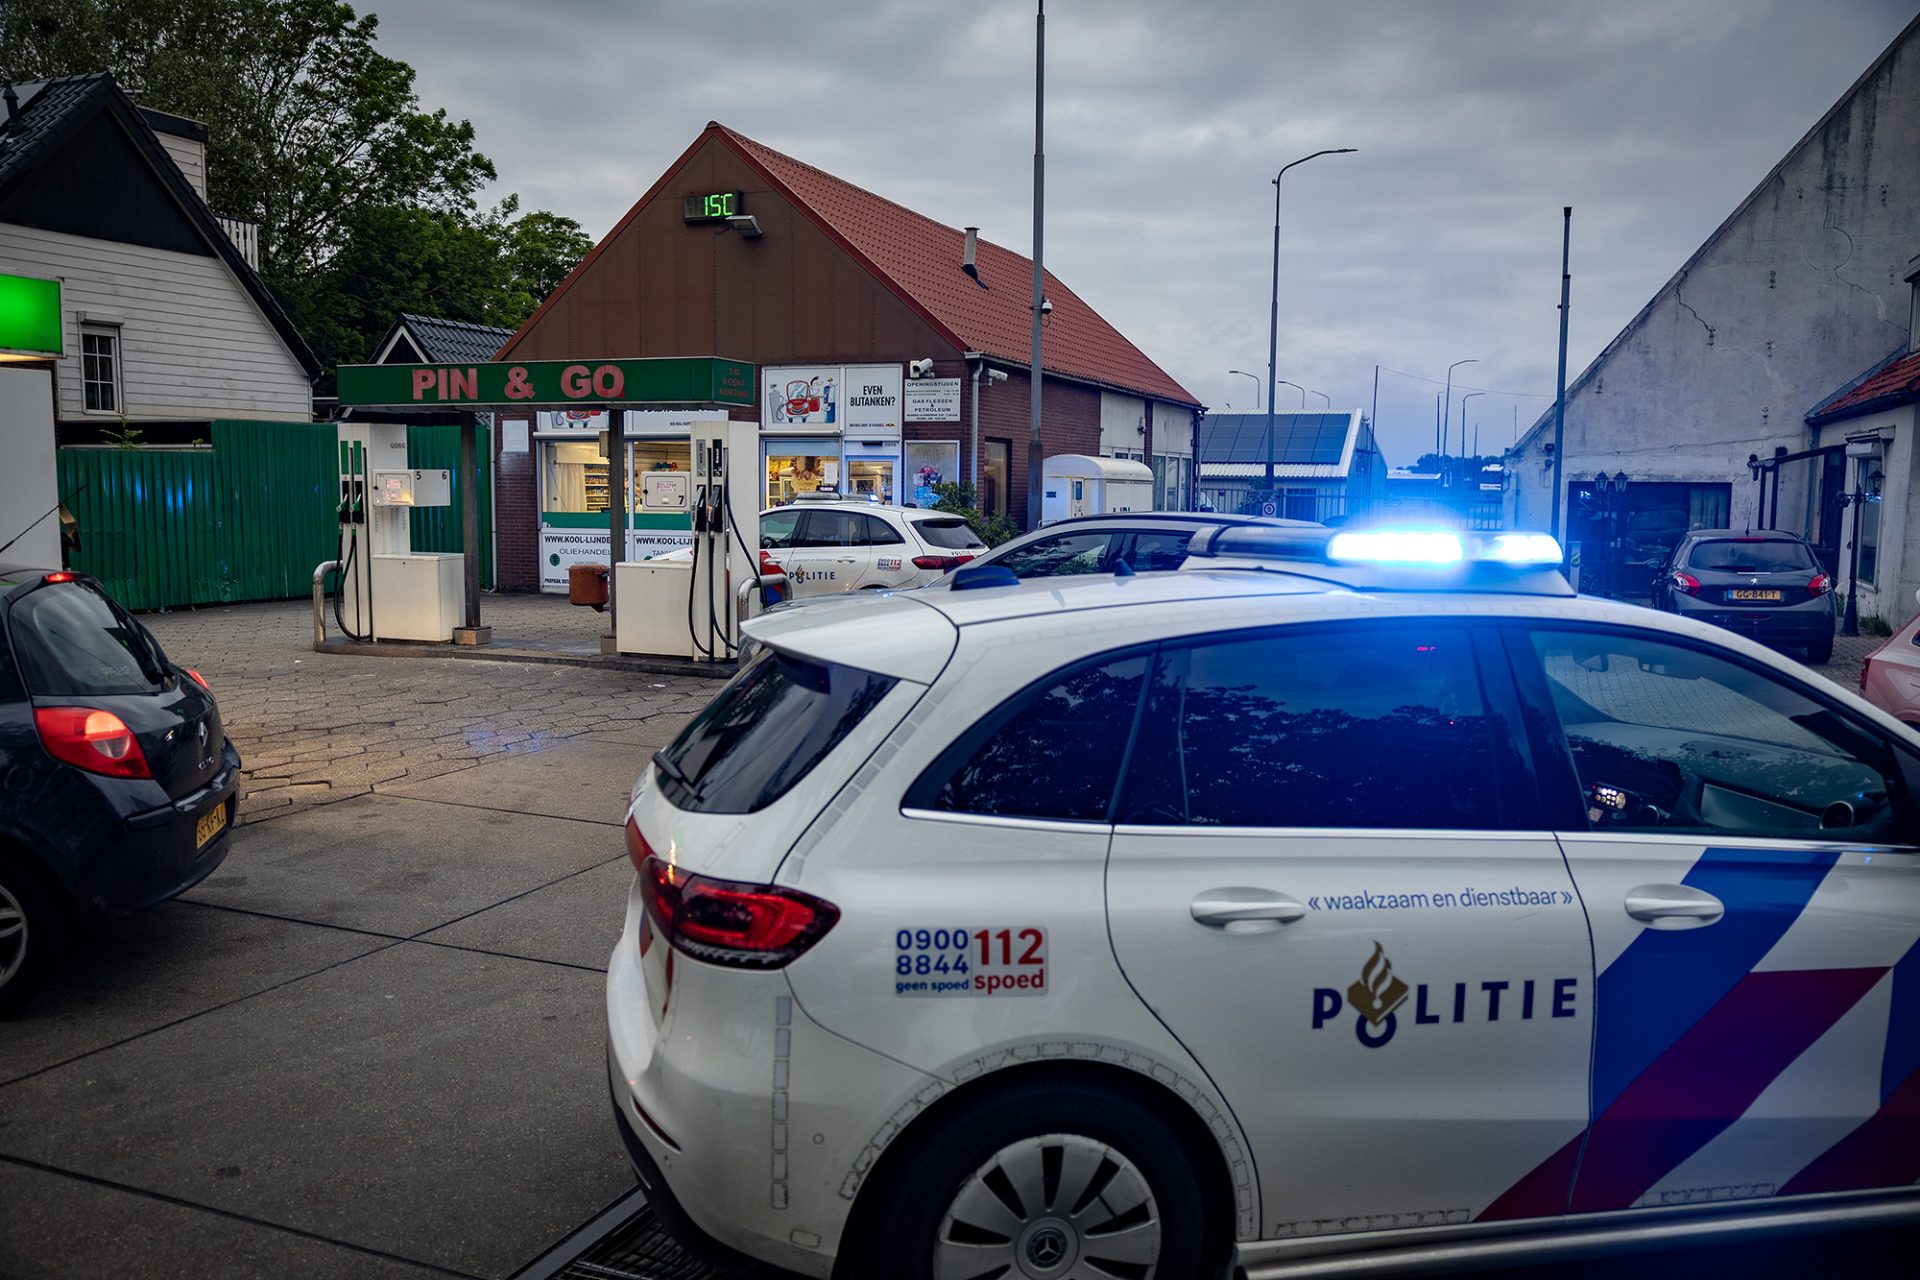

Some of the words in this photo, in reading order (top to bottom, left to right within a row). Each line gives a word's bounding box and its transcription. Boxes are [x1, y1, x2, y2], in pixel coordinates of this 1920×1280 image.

[412, 367, 478, 400] PIN
[504, 366, 535, 399] &
[560, 364, 625, 398] GO
[863, 385, 882, 395] EVEN
[850, 396, 896, 407] BIJTANKEN?
[416, 471, 422, 480] 5
[441, 471, 447, 480] 6
[677, 495, 684, 505] 7
[544, 535, 628, 544] WWW.KOOL-LIJNDE
[559, 547, 611, 556] OLIEHANDEL
[789, 571, 836, 584] POLITIE
[1323, 889, 1430, 911] waakzaam
[1432, 892, 1456, 909] en
[1459, 886, 1557, 907] dienstbaar
[896, 929, 969, 950] 0900
[974, 928, 1044, 966] 112
[896, 954, 969, 975] 8844
[896, 980, 928, 994] geen
[931, 979, 969, 993] spoed
[974, 968, 1044, 995] spoed
[1311, 978, 1577, 1049] POLITIE
